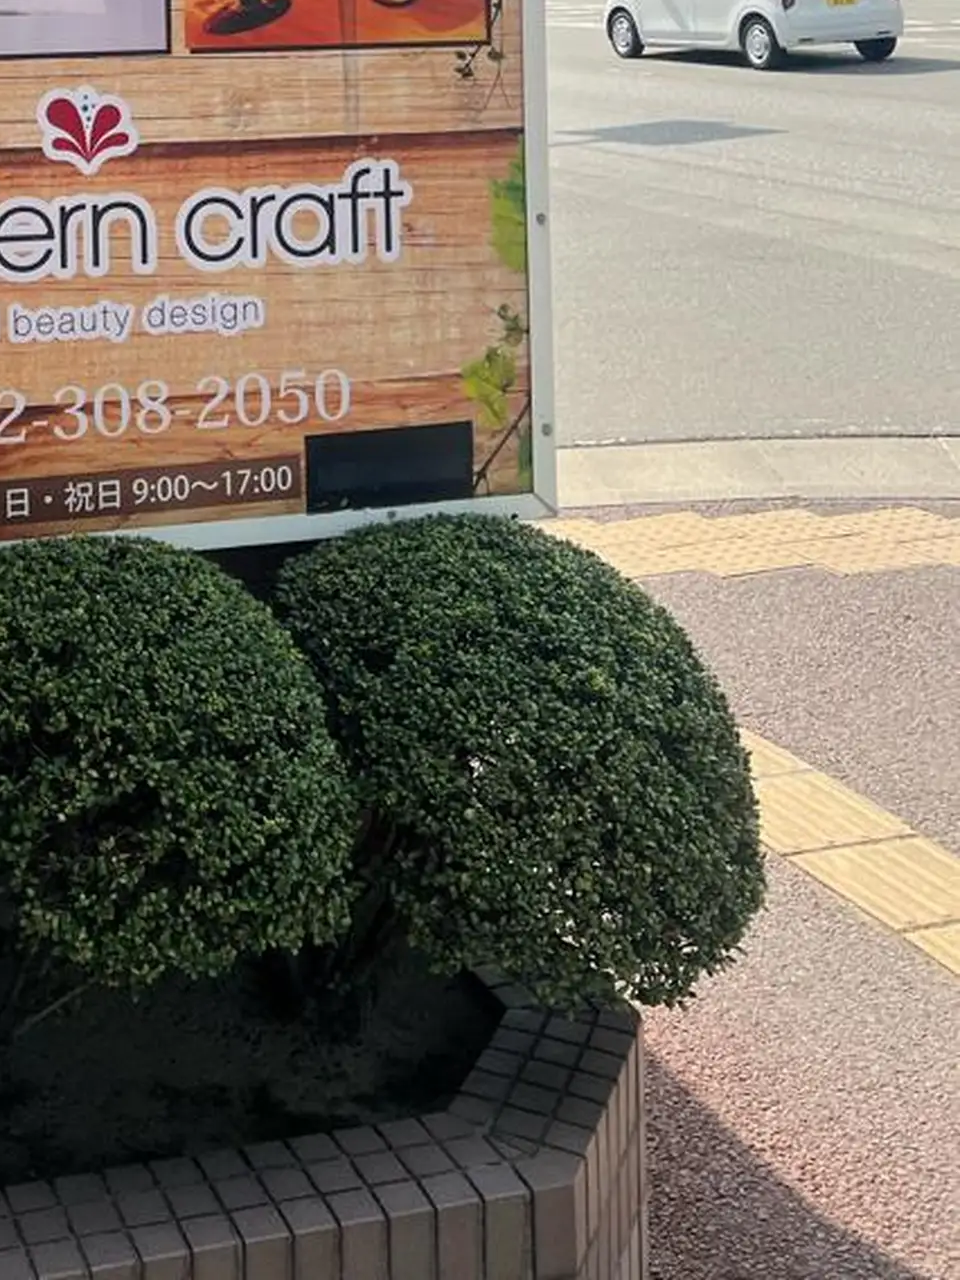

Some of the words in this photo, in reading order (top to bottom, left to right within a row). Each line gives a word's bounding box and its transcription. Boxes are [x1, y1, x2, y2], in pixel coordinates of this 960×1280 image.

[183, 166, 406, 262] craft
[12, 303, 130, 339] beauty
[146, 296, 262, 331] design
